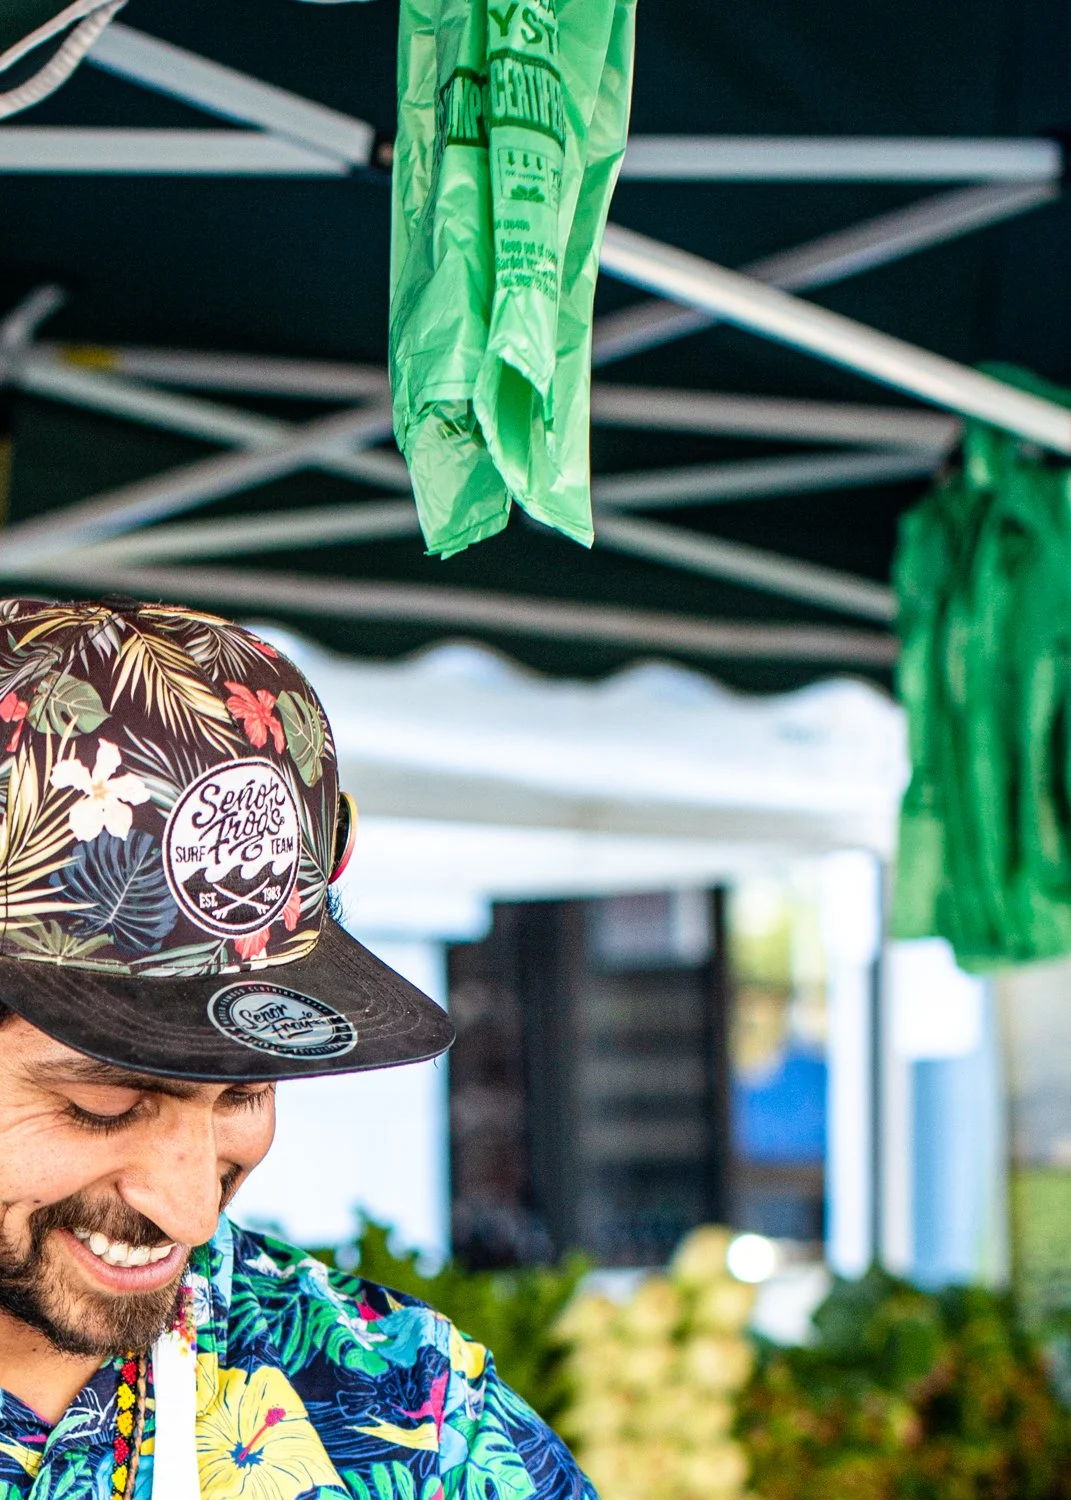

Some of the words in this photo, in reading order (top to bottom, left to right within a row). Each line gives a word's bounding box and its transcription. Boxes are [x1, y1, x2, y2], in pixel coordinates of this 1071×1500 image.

[175, 844, 206, 864] SURF
[270, 836, 294, 855] TEAM
[199, 891, 219, 909] EST.
